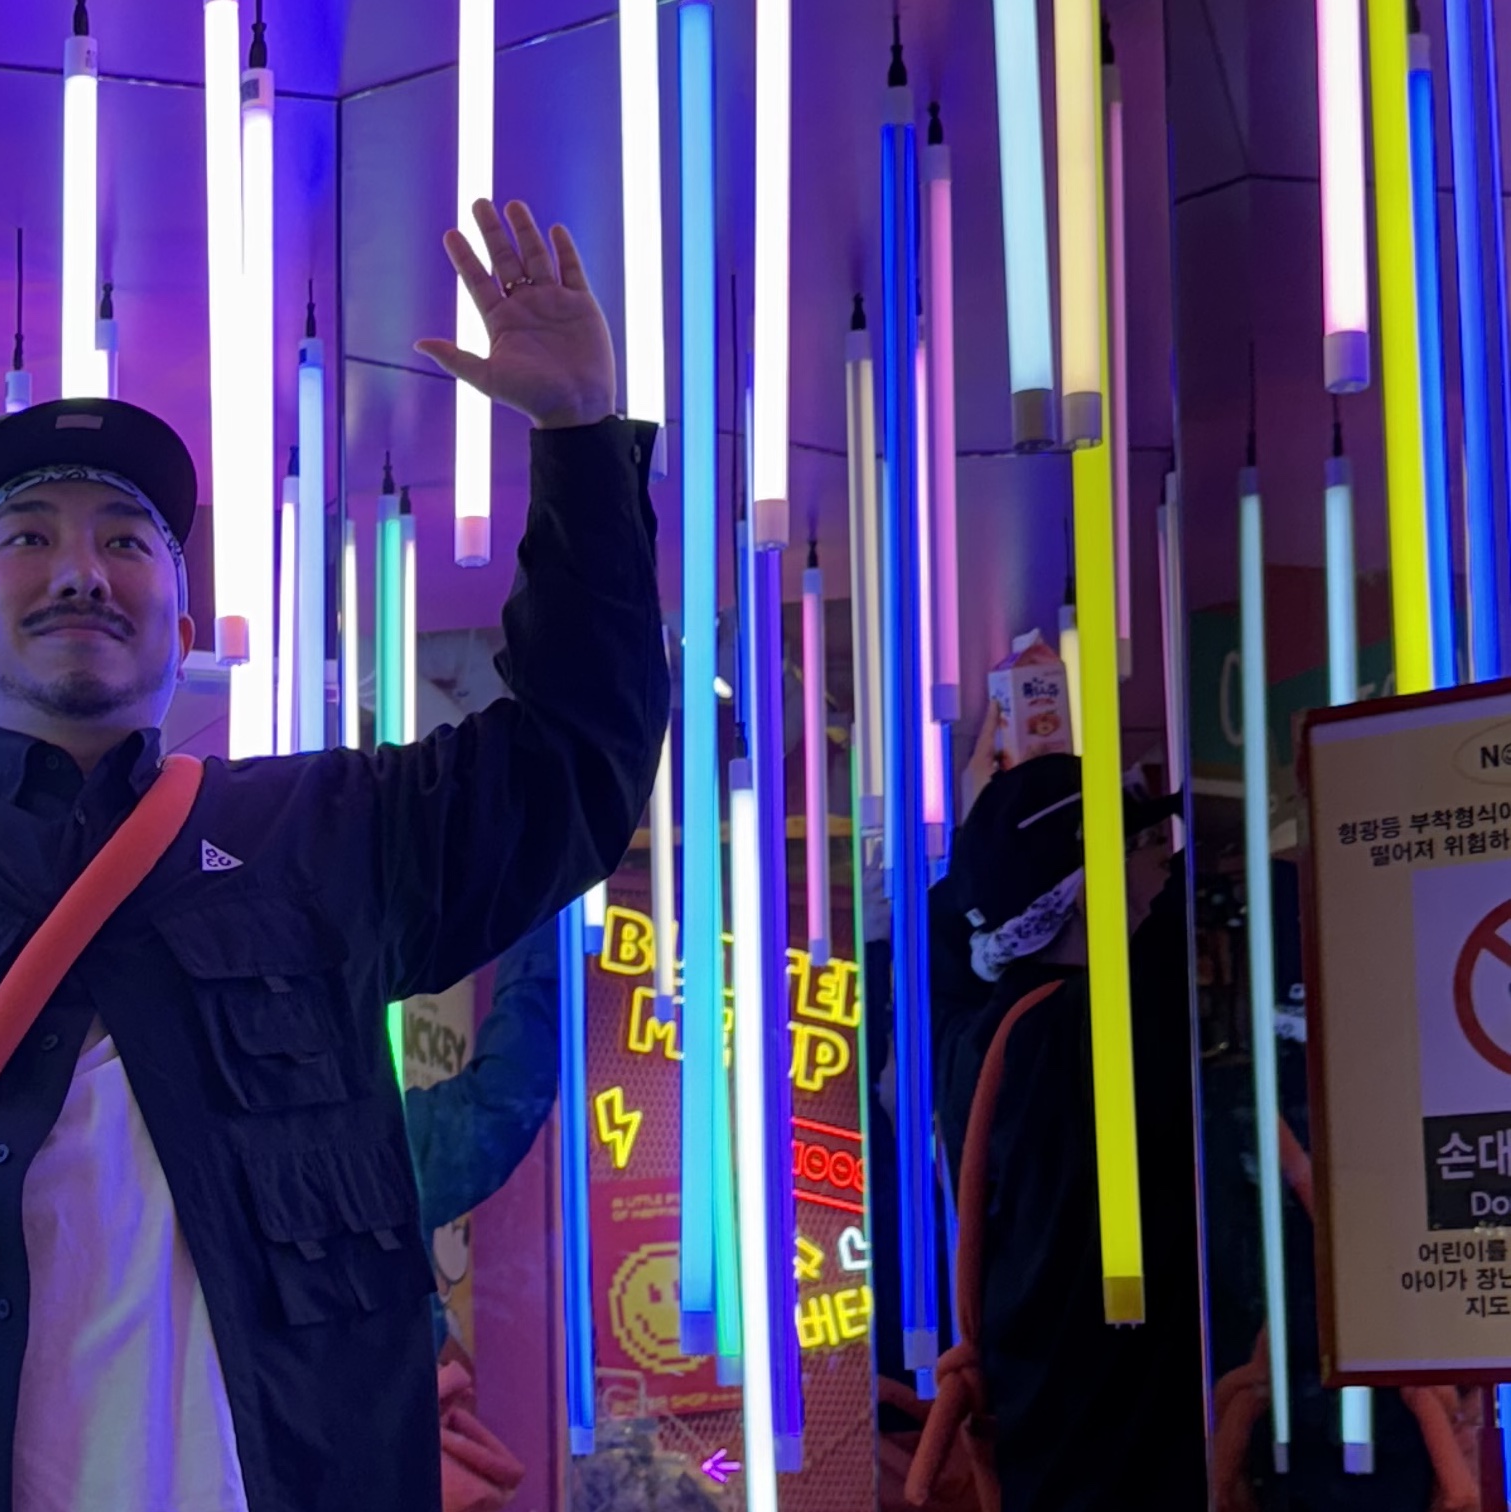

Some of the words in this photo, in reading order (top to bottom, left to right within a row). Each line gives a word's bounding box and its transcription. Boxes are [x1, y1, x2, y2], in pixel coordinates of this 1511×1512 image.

[1339, 816, 1401, 845] 형광등
[1370, 838, 1434, 867] 떨어져
[1418, 1239, 1508, 1265] 어린이를
[1401, 1268, 1468, 1293] 아이가
